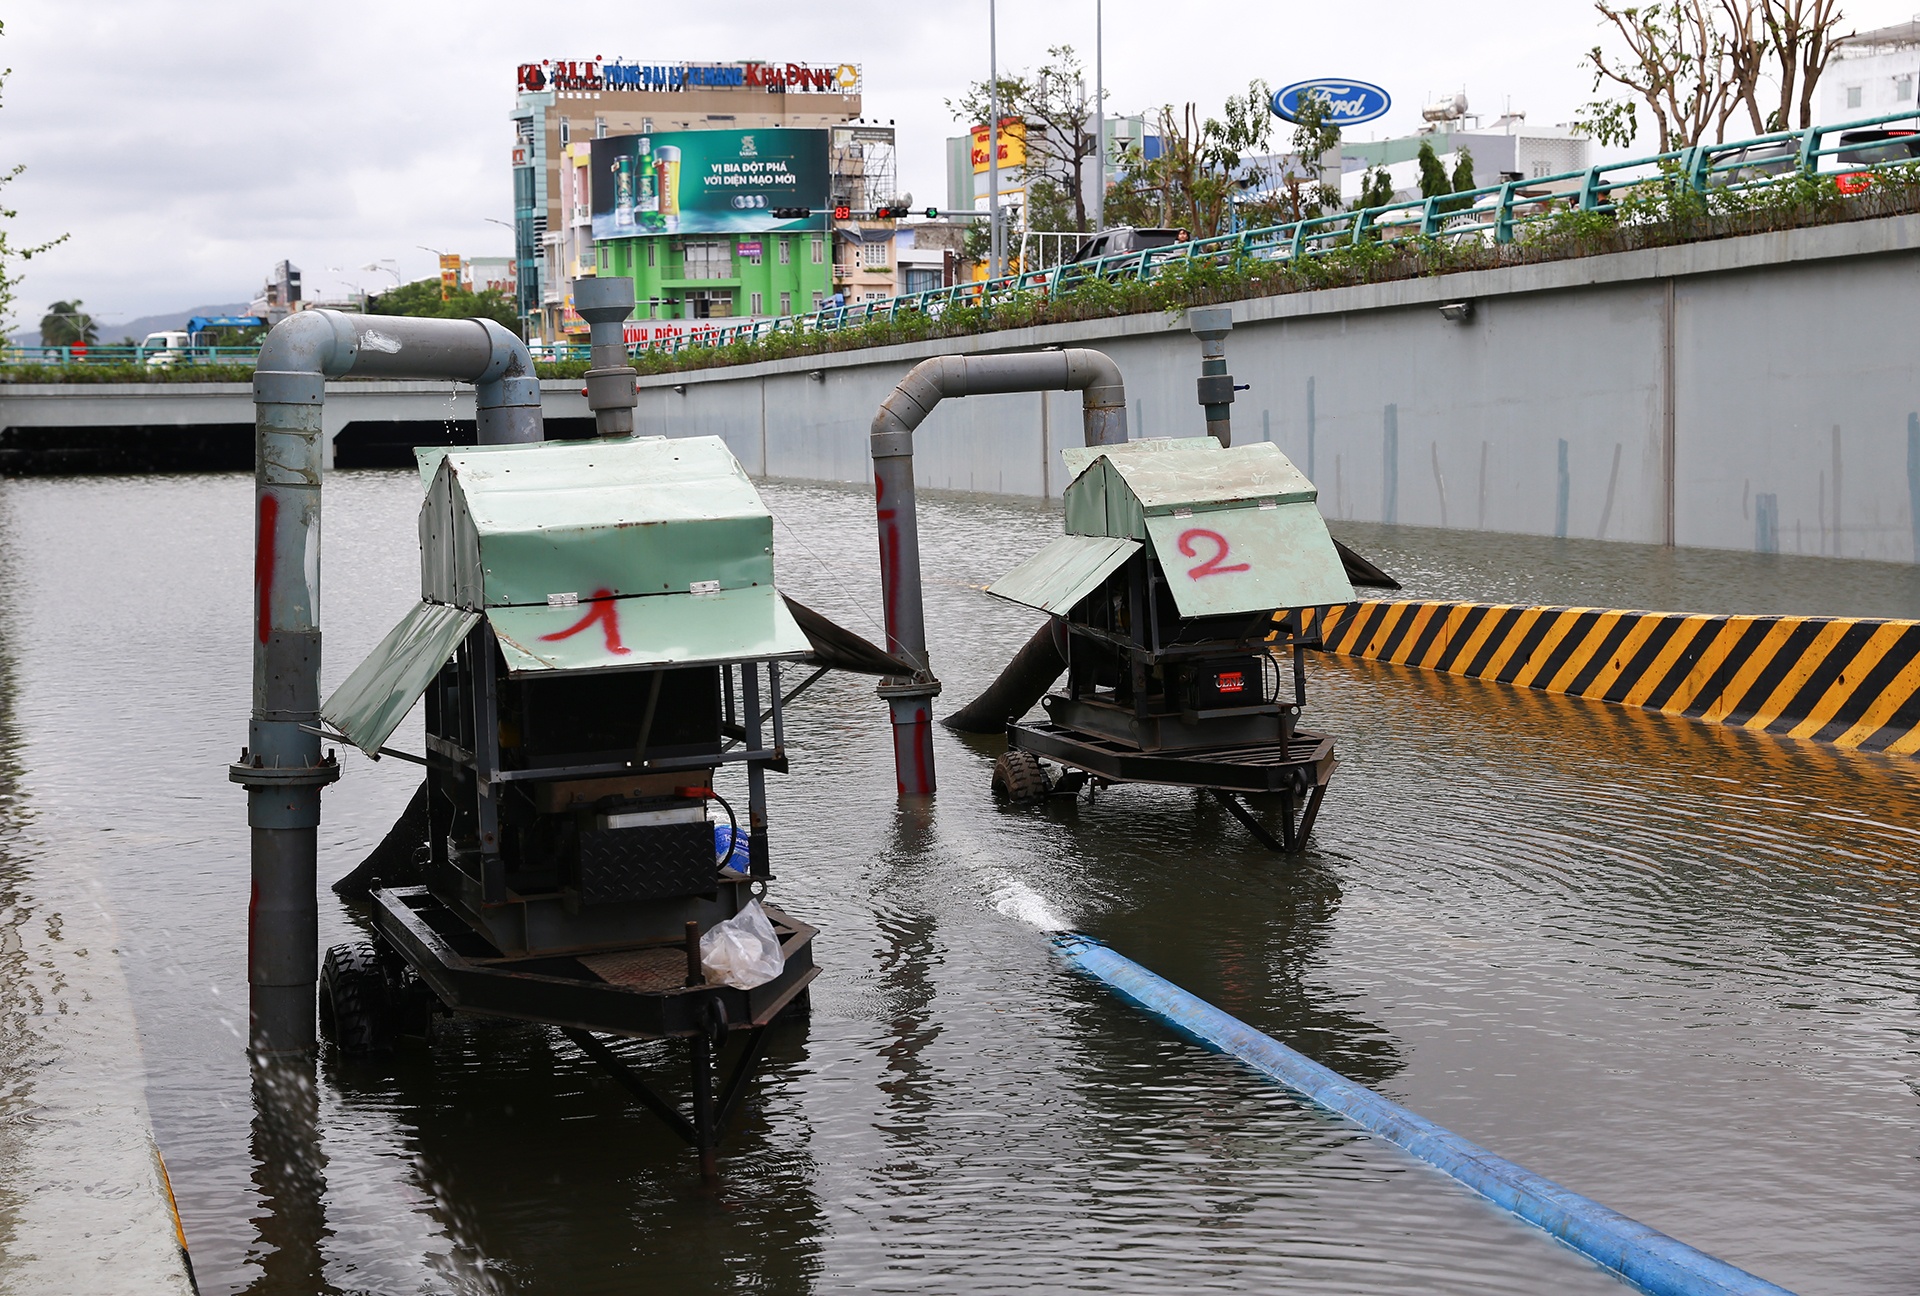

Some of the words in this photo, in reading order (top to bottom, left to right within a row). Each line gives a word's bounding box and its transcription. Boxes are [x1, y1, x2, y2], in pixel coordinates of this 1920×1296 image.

[711, 163, 722, 175] VỊ
[723, 163, 741, 173] BIA
[742, 161, 764, 174] ĐỘT
[766, 160, 788, 172] PHÁ
[664, 173, 672, 207] SPECIAL
[703, 175, 722, 186] VỚI
[723, 174, 747, 187] DIỆN
[748, 175, 773, 186] MẠO
[775, 173, 796, 185] MỚI
[835, 207, 850, 219] 83
[623, 325, 648, 349] KÍNH
[1178, 527, 1251, 580] 2
[538, 588, 632, 655] 1
